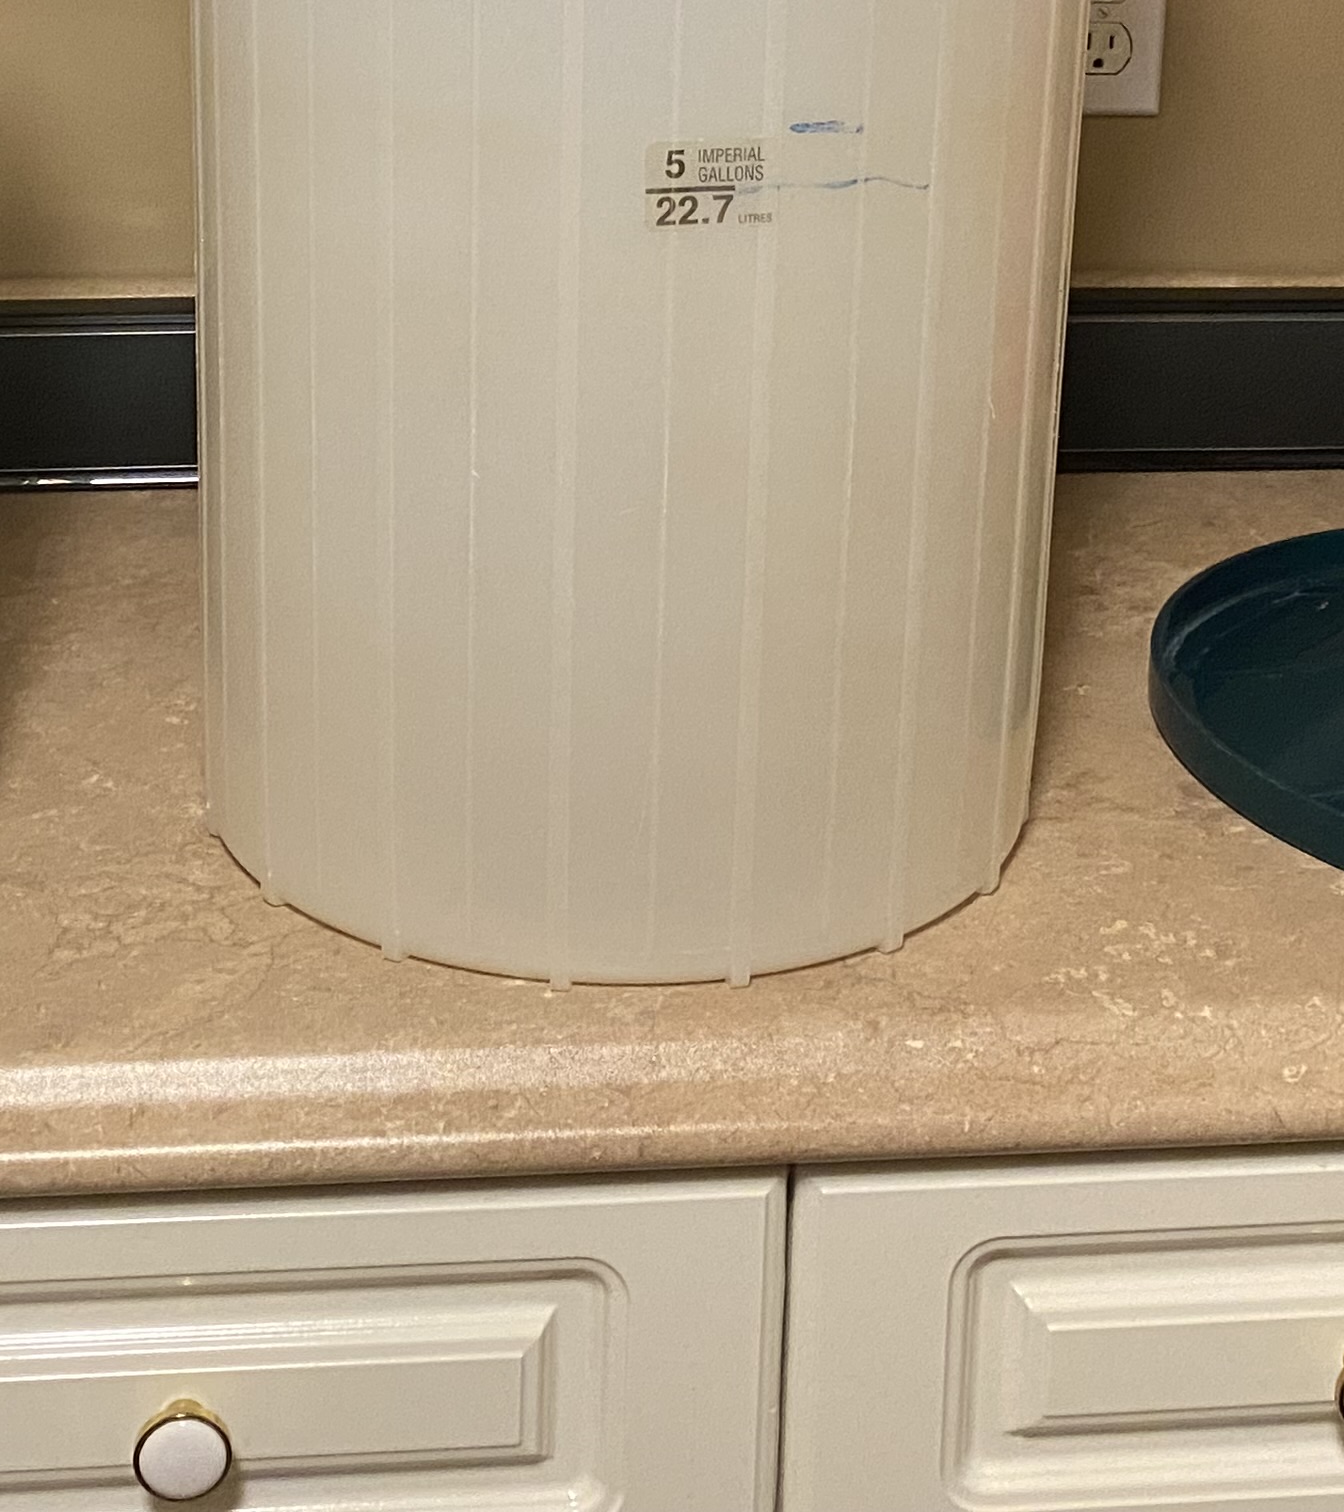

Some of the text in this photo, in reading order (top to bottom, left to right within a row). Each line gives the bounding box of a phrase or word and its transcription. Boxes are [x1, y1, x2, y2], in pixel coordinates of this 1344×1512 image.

[664, 146, 766, 180] 5 IMPERIAL
[697, 164, 765, 183] GALLONS
[655, 194, 774, 227] 22.7 LITRES
